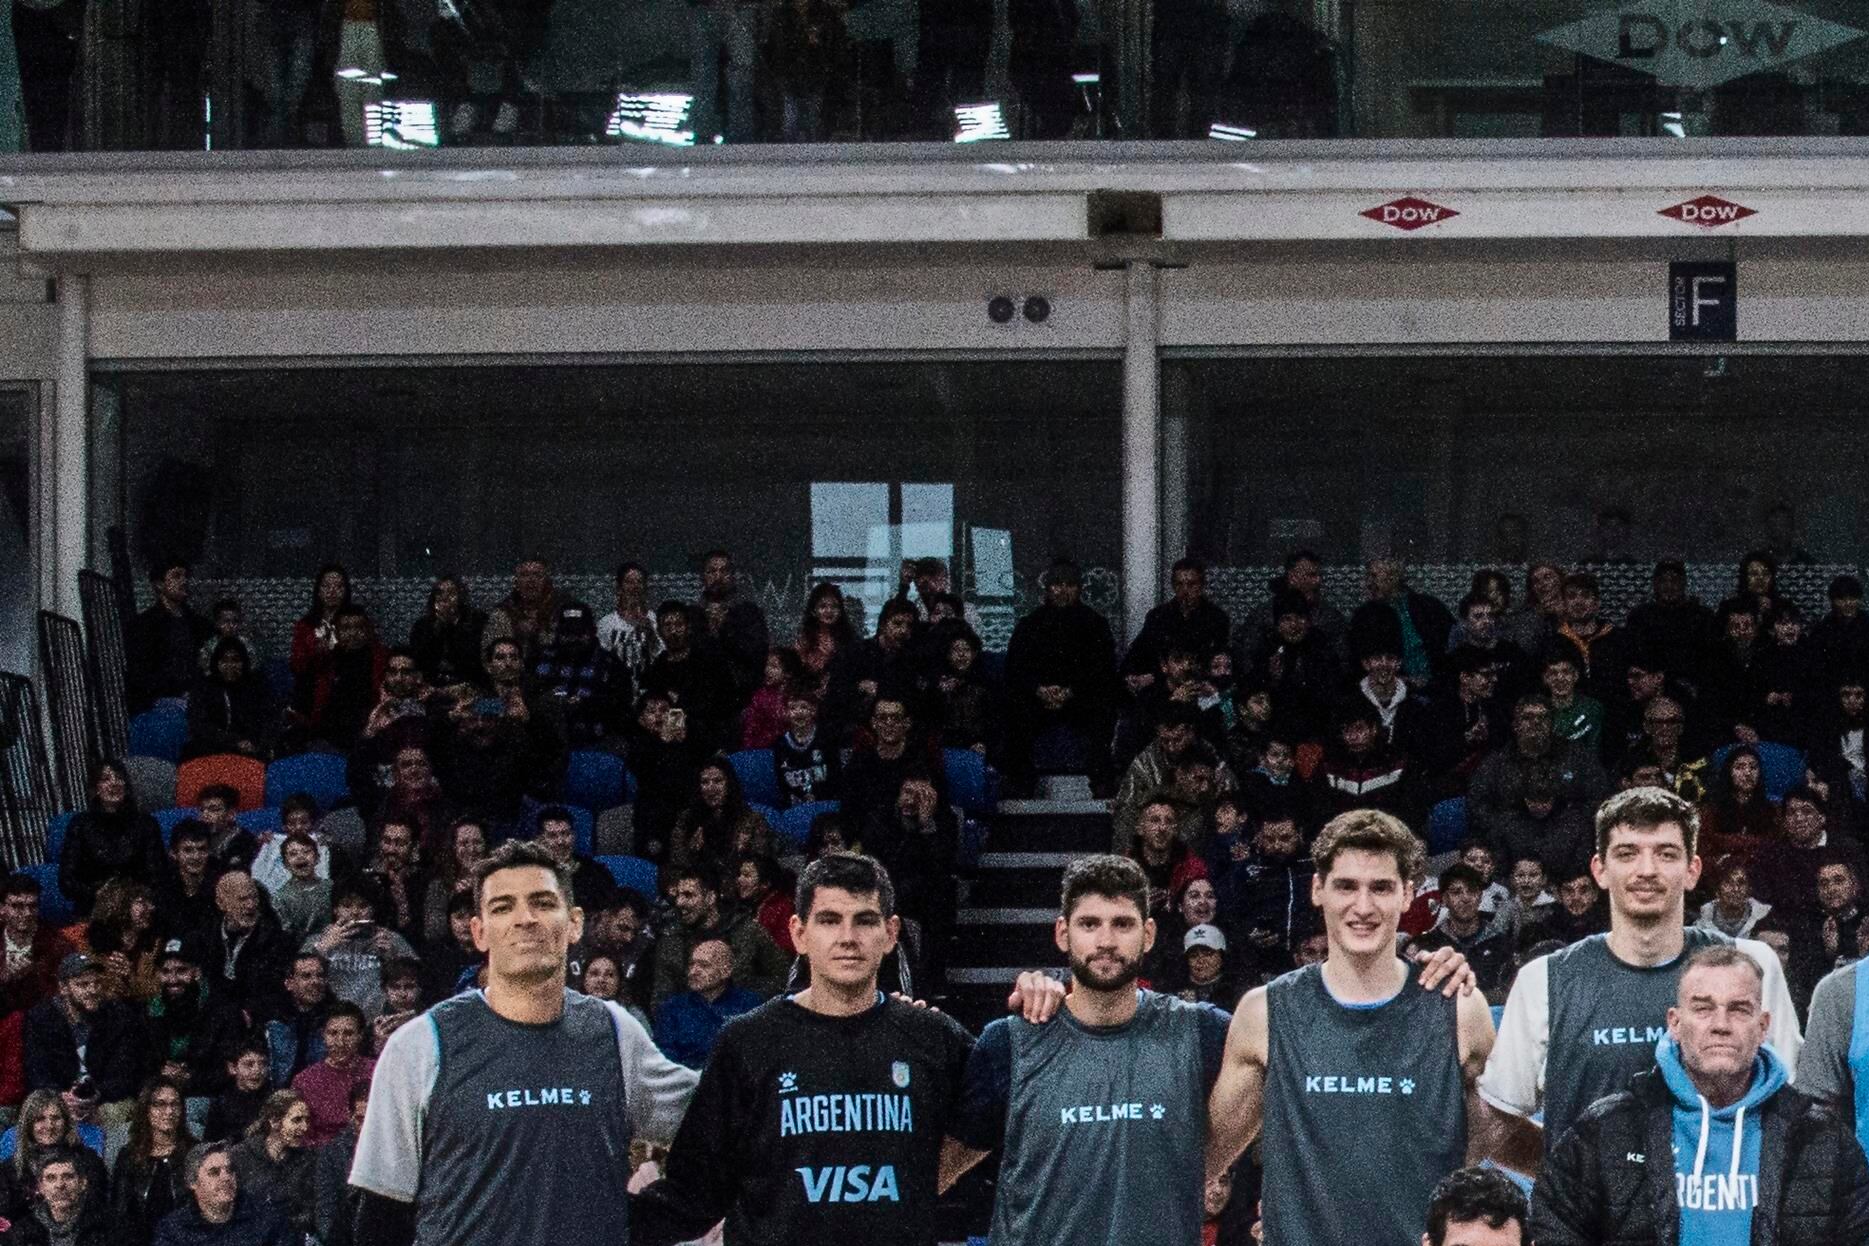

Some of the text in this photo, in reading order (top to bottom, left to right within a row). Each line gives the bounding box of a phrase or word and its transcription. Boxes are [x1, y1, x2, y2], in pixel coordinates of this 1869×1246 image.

[1615, 12, 1801, 60] DOW
[1382, 204, 1442, 223] DOW
[1680, 202, 1738, 222] DOW
[1674, 276, 1687, 326] SECTOR
[1692, 275, 1726, 326] F
[1594, 1027, 1664, 1045] KELM
[1306, 1076, 1393, 1094] KELME
[487, 1088, 574, 1110] KELME
[781, 1093, 913, 1137] ARGENTINA
[1061, 1103, 1143, 1124] KELME
[794, 1164, 900, 1203] VISA
